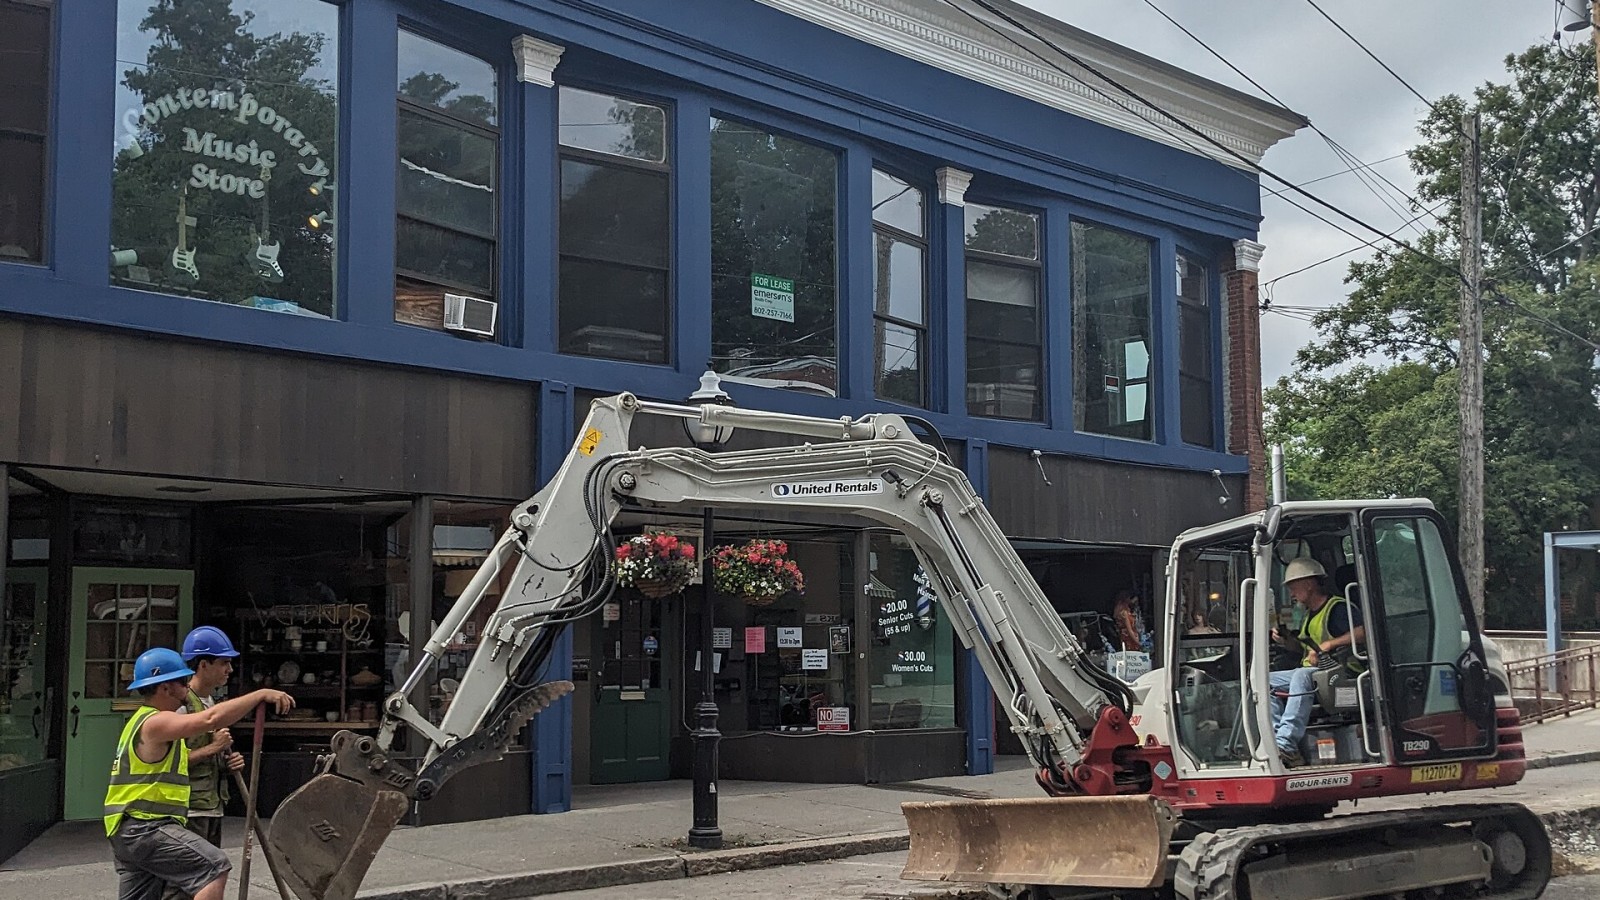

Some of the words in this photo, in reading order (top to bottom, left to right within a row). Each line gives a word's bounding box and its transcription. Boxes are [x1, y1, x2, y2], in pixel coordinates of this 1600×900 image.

[122, 86, 330, 178] Contemporary
[182, 127, 277, 168] Music
[190, 163, 266, 199] Store
[754, 276, 769, 287] FOR
[770, 279, 791, 291] LEASE
[753, 289, 793, 303] emerson's
[792, 483, 832, 495] United
[835, 481, 878, 493] Rentals
[886, 599, 908, 613] 20.00
[878, 614, 899, 627] Senior
[899, 611, 914, 621] Cuts
[884, 625, 894, 637] (55
[894, 624, 900, 633] &
[900, 623, 911, 633] up)
[904, 651, 926, 661] 30.00
[891, 664, 919, 672] Women's
[919, 664, 934, 672] Cuts
[820, 710, 833, 721] NO
[1403, 740, 1430, 752] TB290
[1420, 764, 1458, 781] 11270712
[1289, 776, 1349, 789] 800-UR-RENTS
